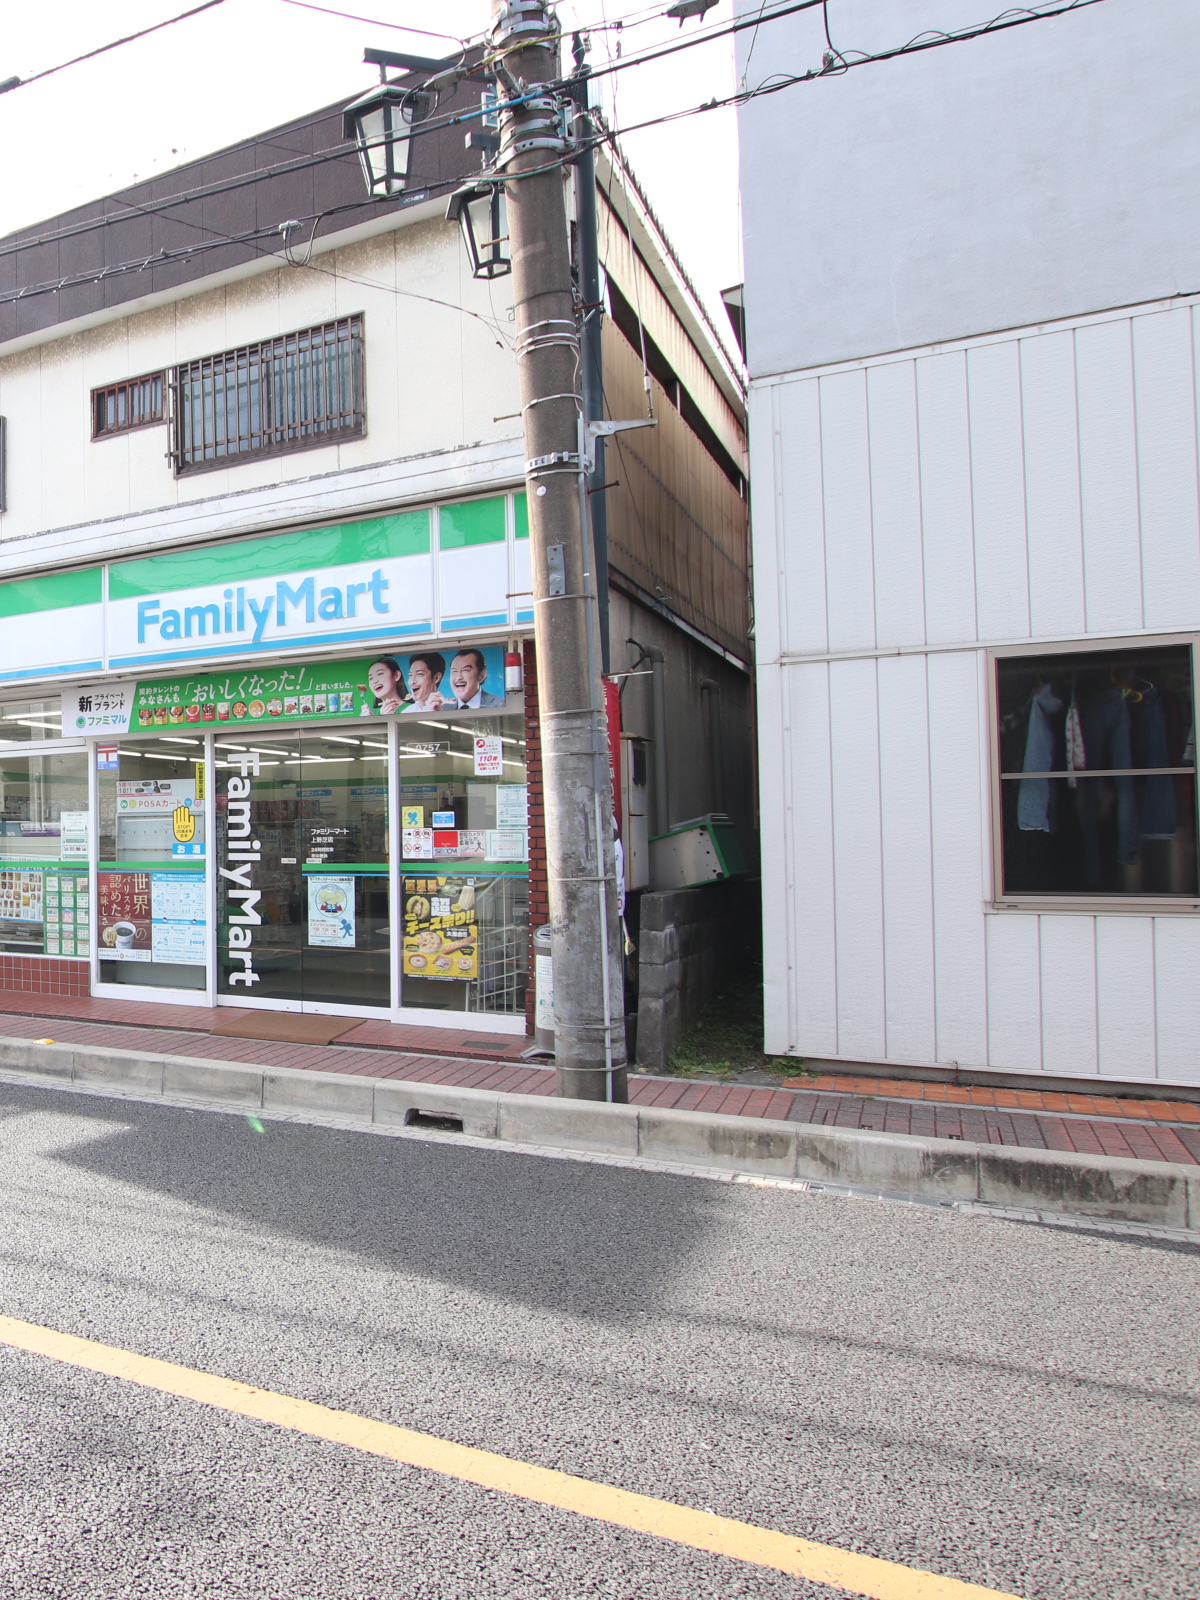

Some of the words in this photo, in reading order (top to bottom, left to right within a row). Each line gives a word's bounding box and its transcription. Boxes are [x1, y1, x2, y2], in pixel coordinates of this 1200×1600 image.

[137, 567, 390, 643] FamilyMart
[94, 692, 124, 701] プライベート
[139, 685, 180, 696] 契約タレントの
[78, 695, 93, 713] 新
[94, 699, 126, 711] ブランド
[139, 694, 180, 706] みなさんも
[88, 714, 127, 727] ファミマル
[416, 743, 441, 752] 0757
[310, 836, 334, 844] 上野芝店
[176, 844, 201, 855] お酒
[219, 752, 261, 987] FamilyMart
[109, 874, 122, 917] 認めた
[123, 876, 132, 921] バリスタが
[100, 884, 110, 926] 美味しさ
[132, 873, 151, 941] 世界一の
[430, 897, 451, 917] 超
